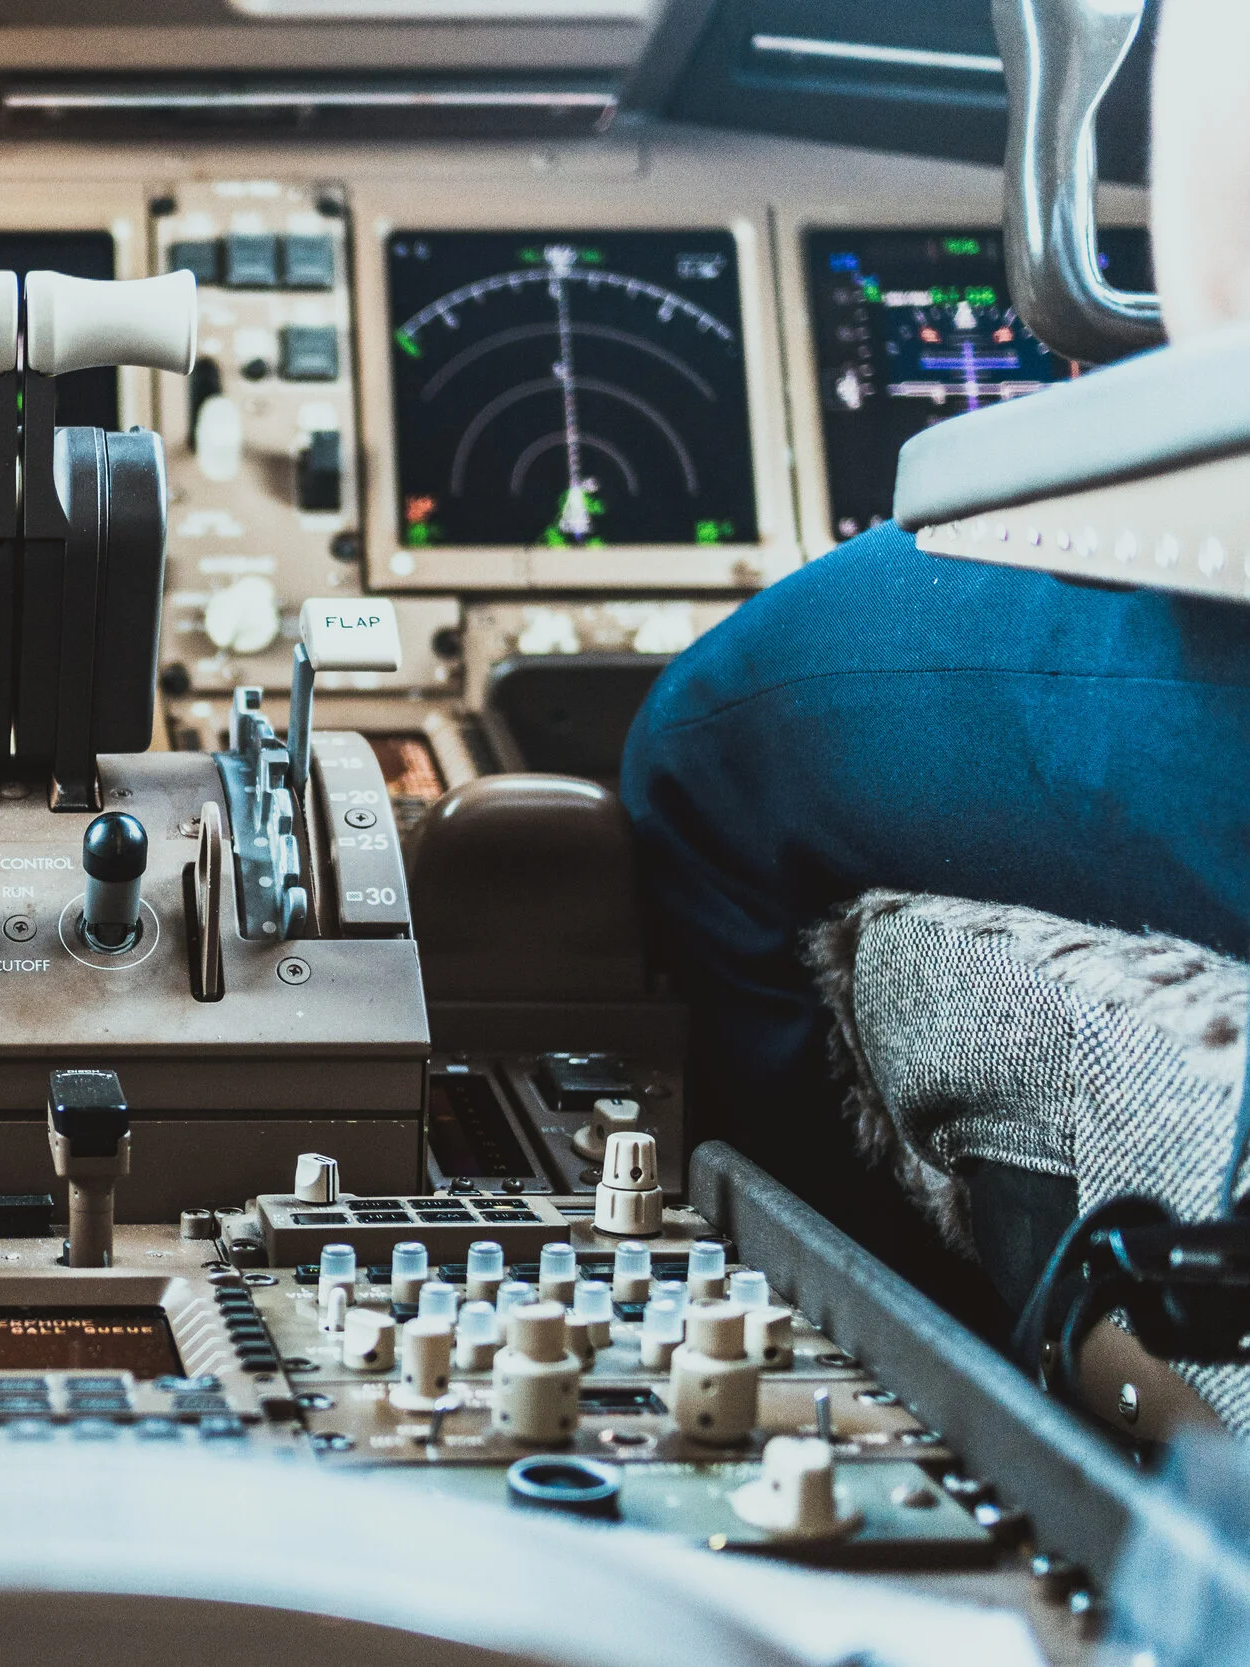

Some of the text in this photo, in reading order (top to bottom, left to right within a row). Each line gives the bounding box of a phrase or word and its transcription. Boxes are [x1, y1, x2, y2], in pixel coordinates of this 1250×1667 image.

[325, 616, 380, 628] FLAP
[349, 790, 379, 804] 20
[357, 833, 389, 851] 25
[0, 857, 74, 870] CONTROL
[2, 886, 34, 898] RUN
[365, 887, 396, 906] 30
[11, 1326, 66, 1335] CALL
[84, 1326, 153, 1335] QUEUE
